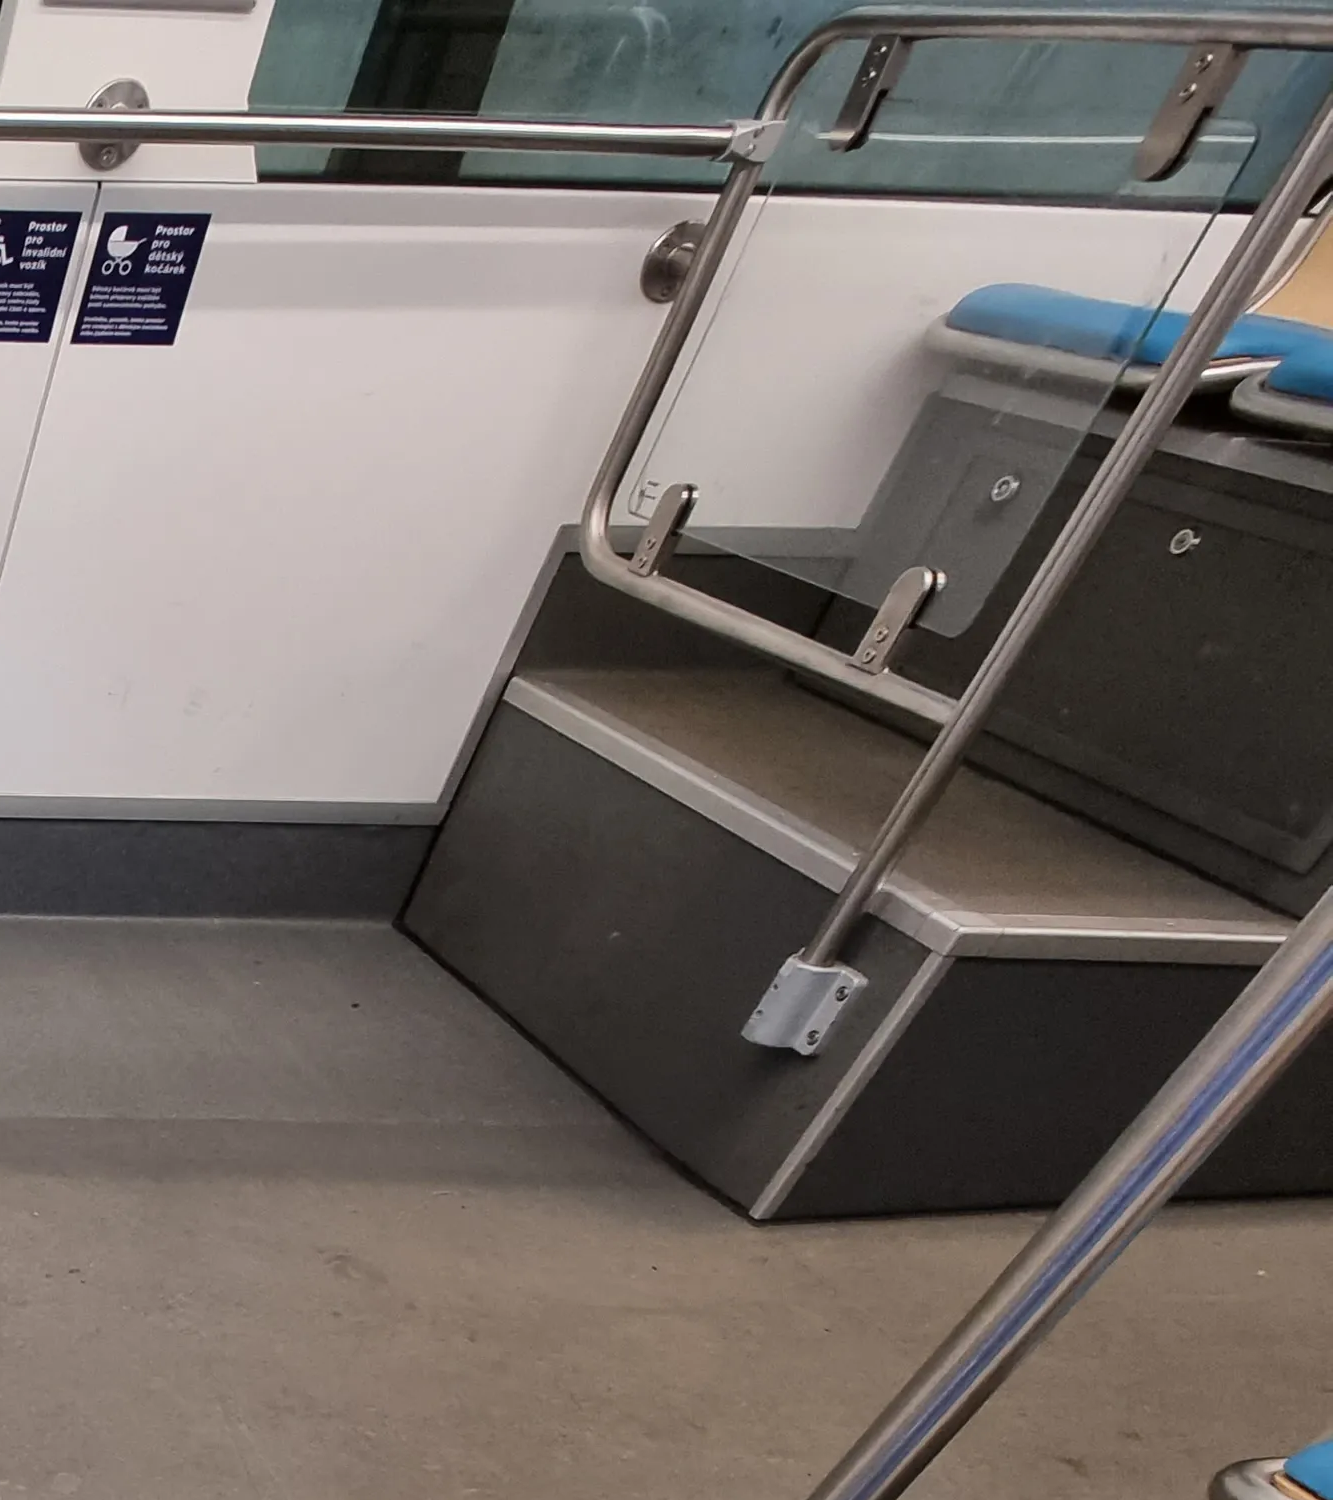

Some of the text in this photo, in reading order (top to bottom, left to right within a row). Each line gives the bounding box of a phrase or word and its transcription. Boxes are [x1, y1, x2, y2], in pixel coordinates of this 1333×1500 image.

[28, 221, 68, 232] Prostor
[155, 224, 195, 236] Prostor
[24, 236, 44, 247] pro
[151, 240, 171, 250] pro
[21, 246, 68, 258] invalidní
[148, 250, 184, 263] dětský
[19, 260, 47, 271] vozík
[144, 263, 187, 274] kočárek
